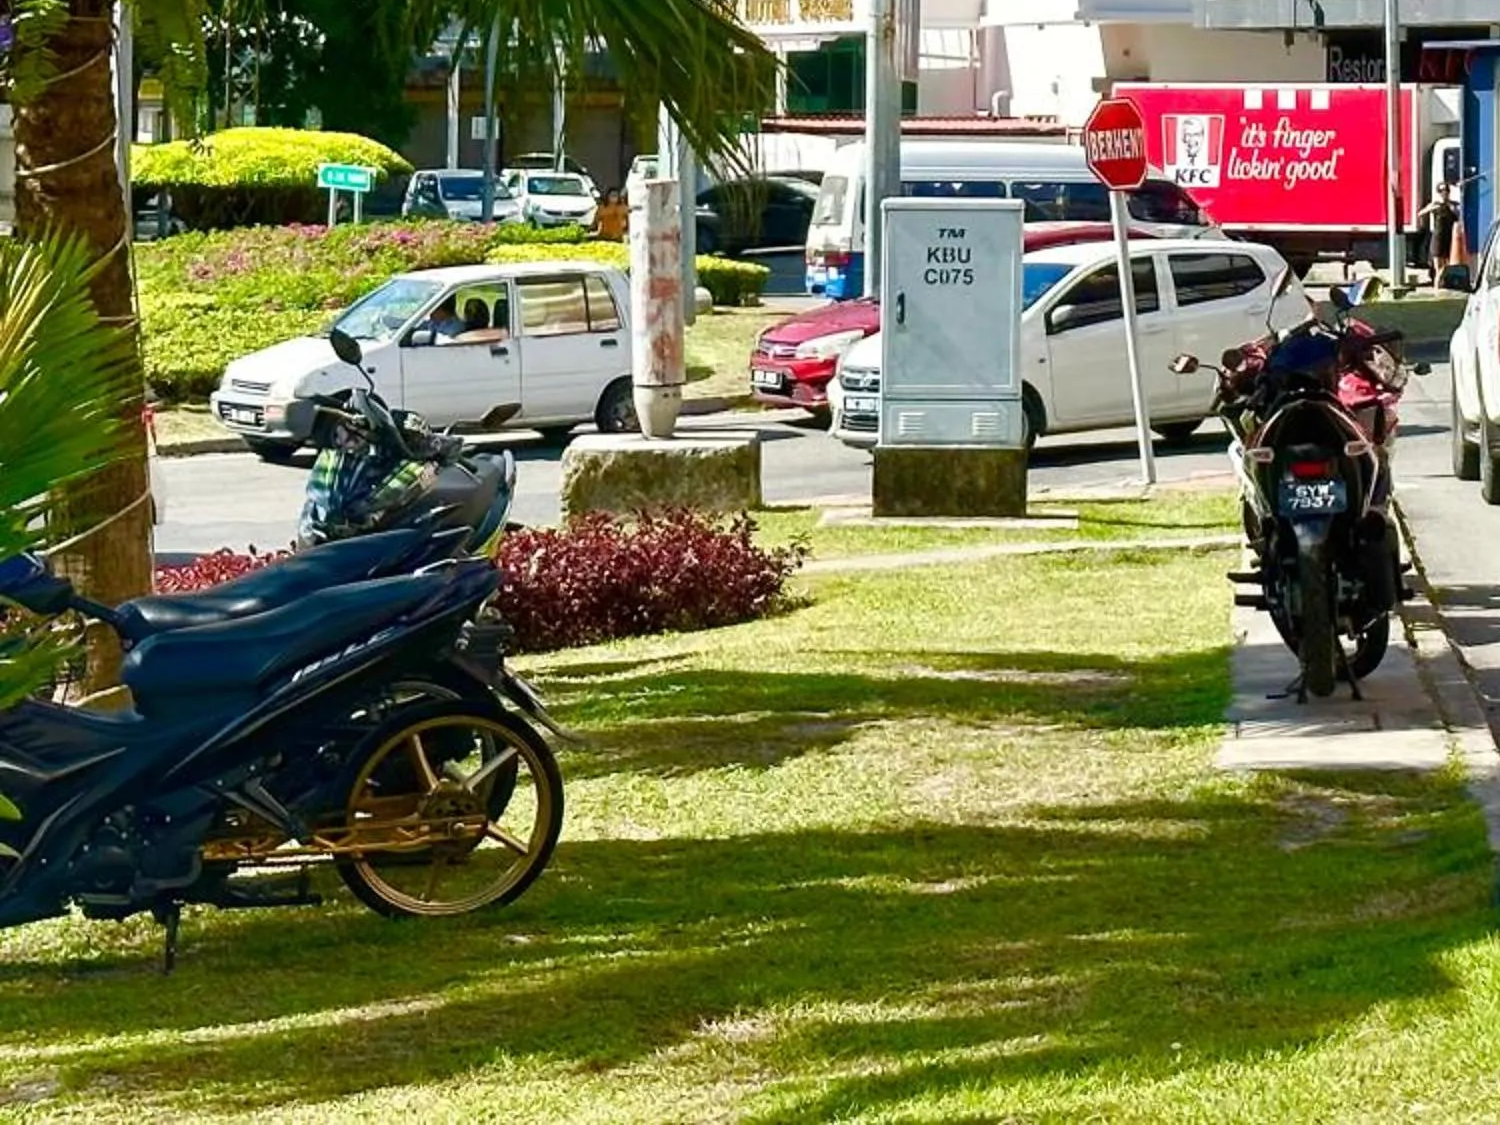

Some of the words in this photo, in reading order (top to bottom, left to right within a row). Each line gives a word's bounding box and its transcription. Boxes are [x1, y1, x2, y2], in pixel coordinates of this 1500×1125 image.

[1271, 116, 1336, 159] finger
[1174, 169, 1213, 185] KFC
[926, 246, 972, 264] KBU
[923, 268, 975, 286] C075
